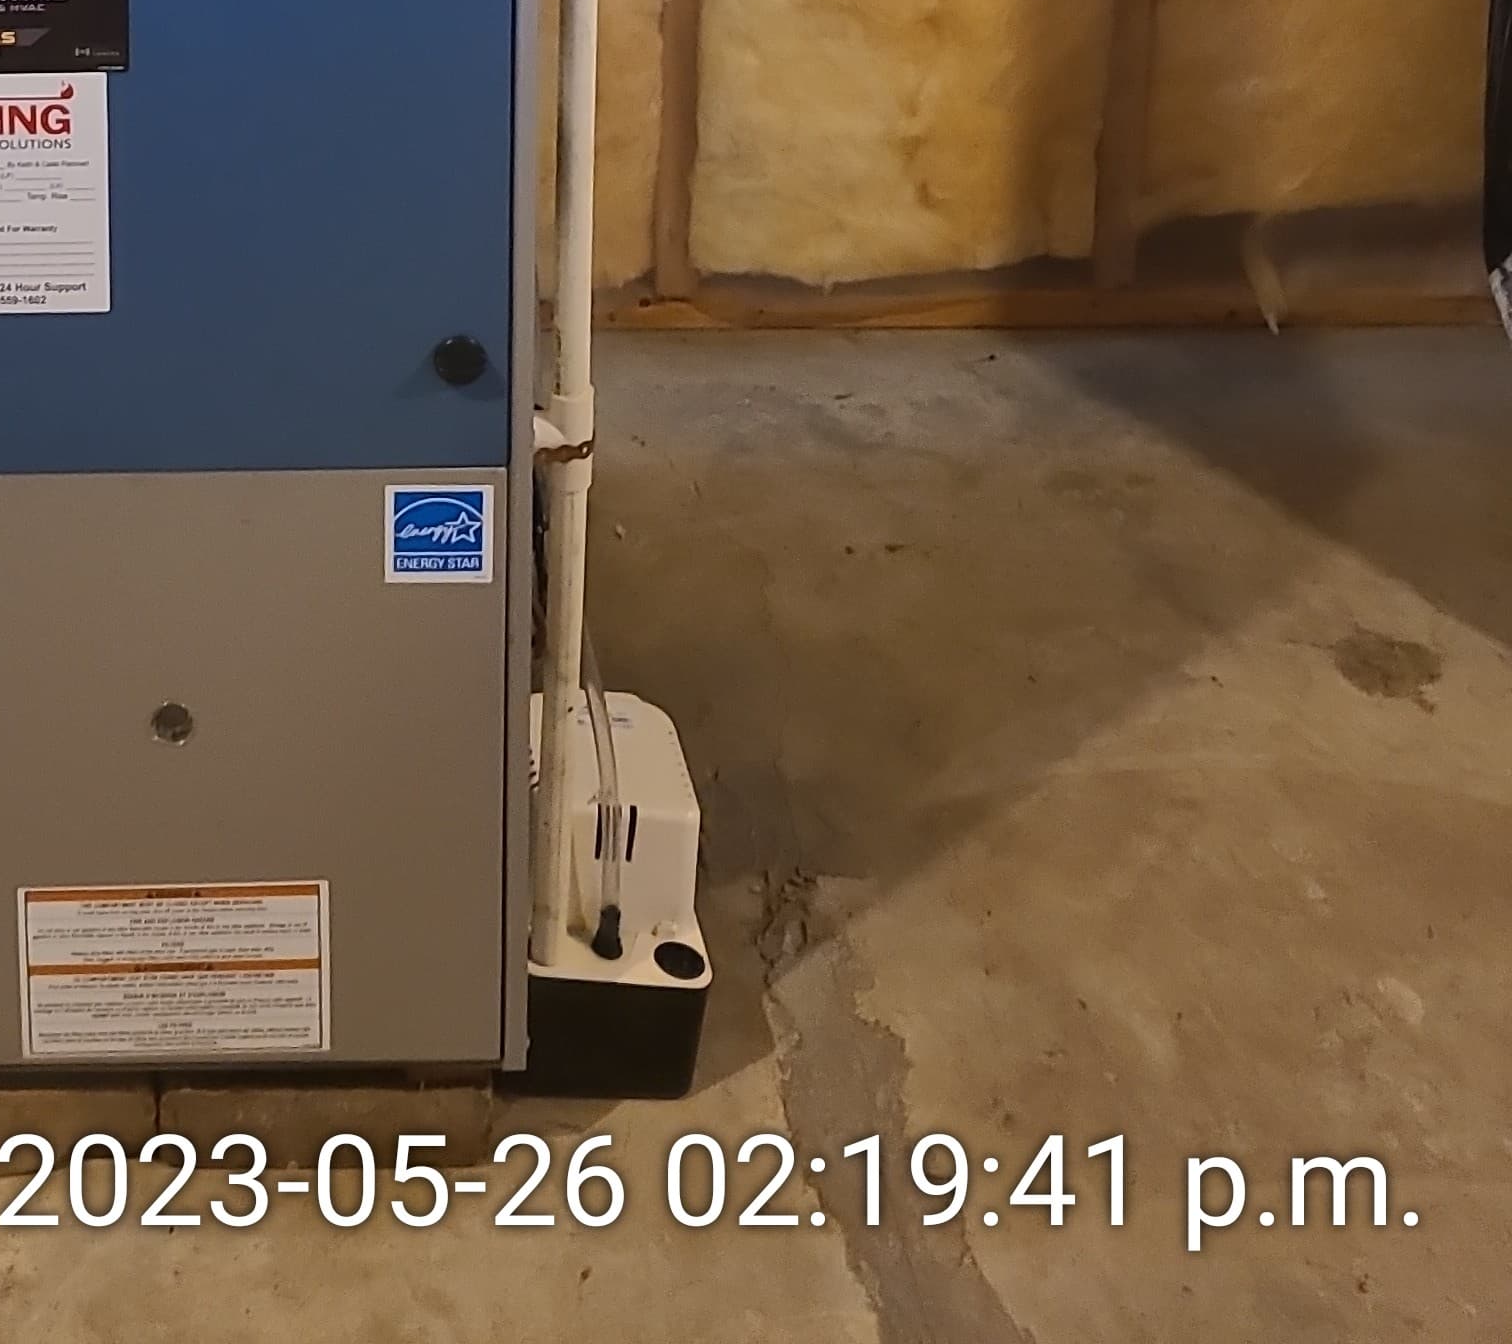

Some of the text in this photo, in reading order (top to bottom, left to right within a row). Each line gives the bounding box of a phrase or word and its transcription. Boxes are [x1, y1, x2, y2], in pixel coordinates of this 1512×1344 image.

[6, 225, 21, 233] For
[22, 225, 58, 234] Warranty
[0, 283, 12, 292] 24
[15, 283, 41, 292] Hour
[44, 282, 88, 294] Support
[396, 557, 480, 570] ENERGY STAR
